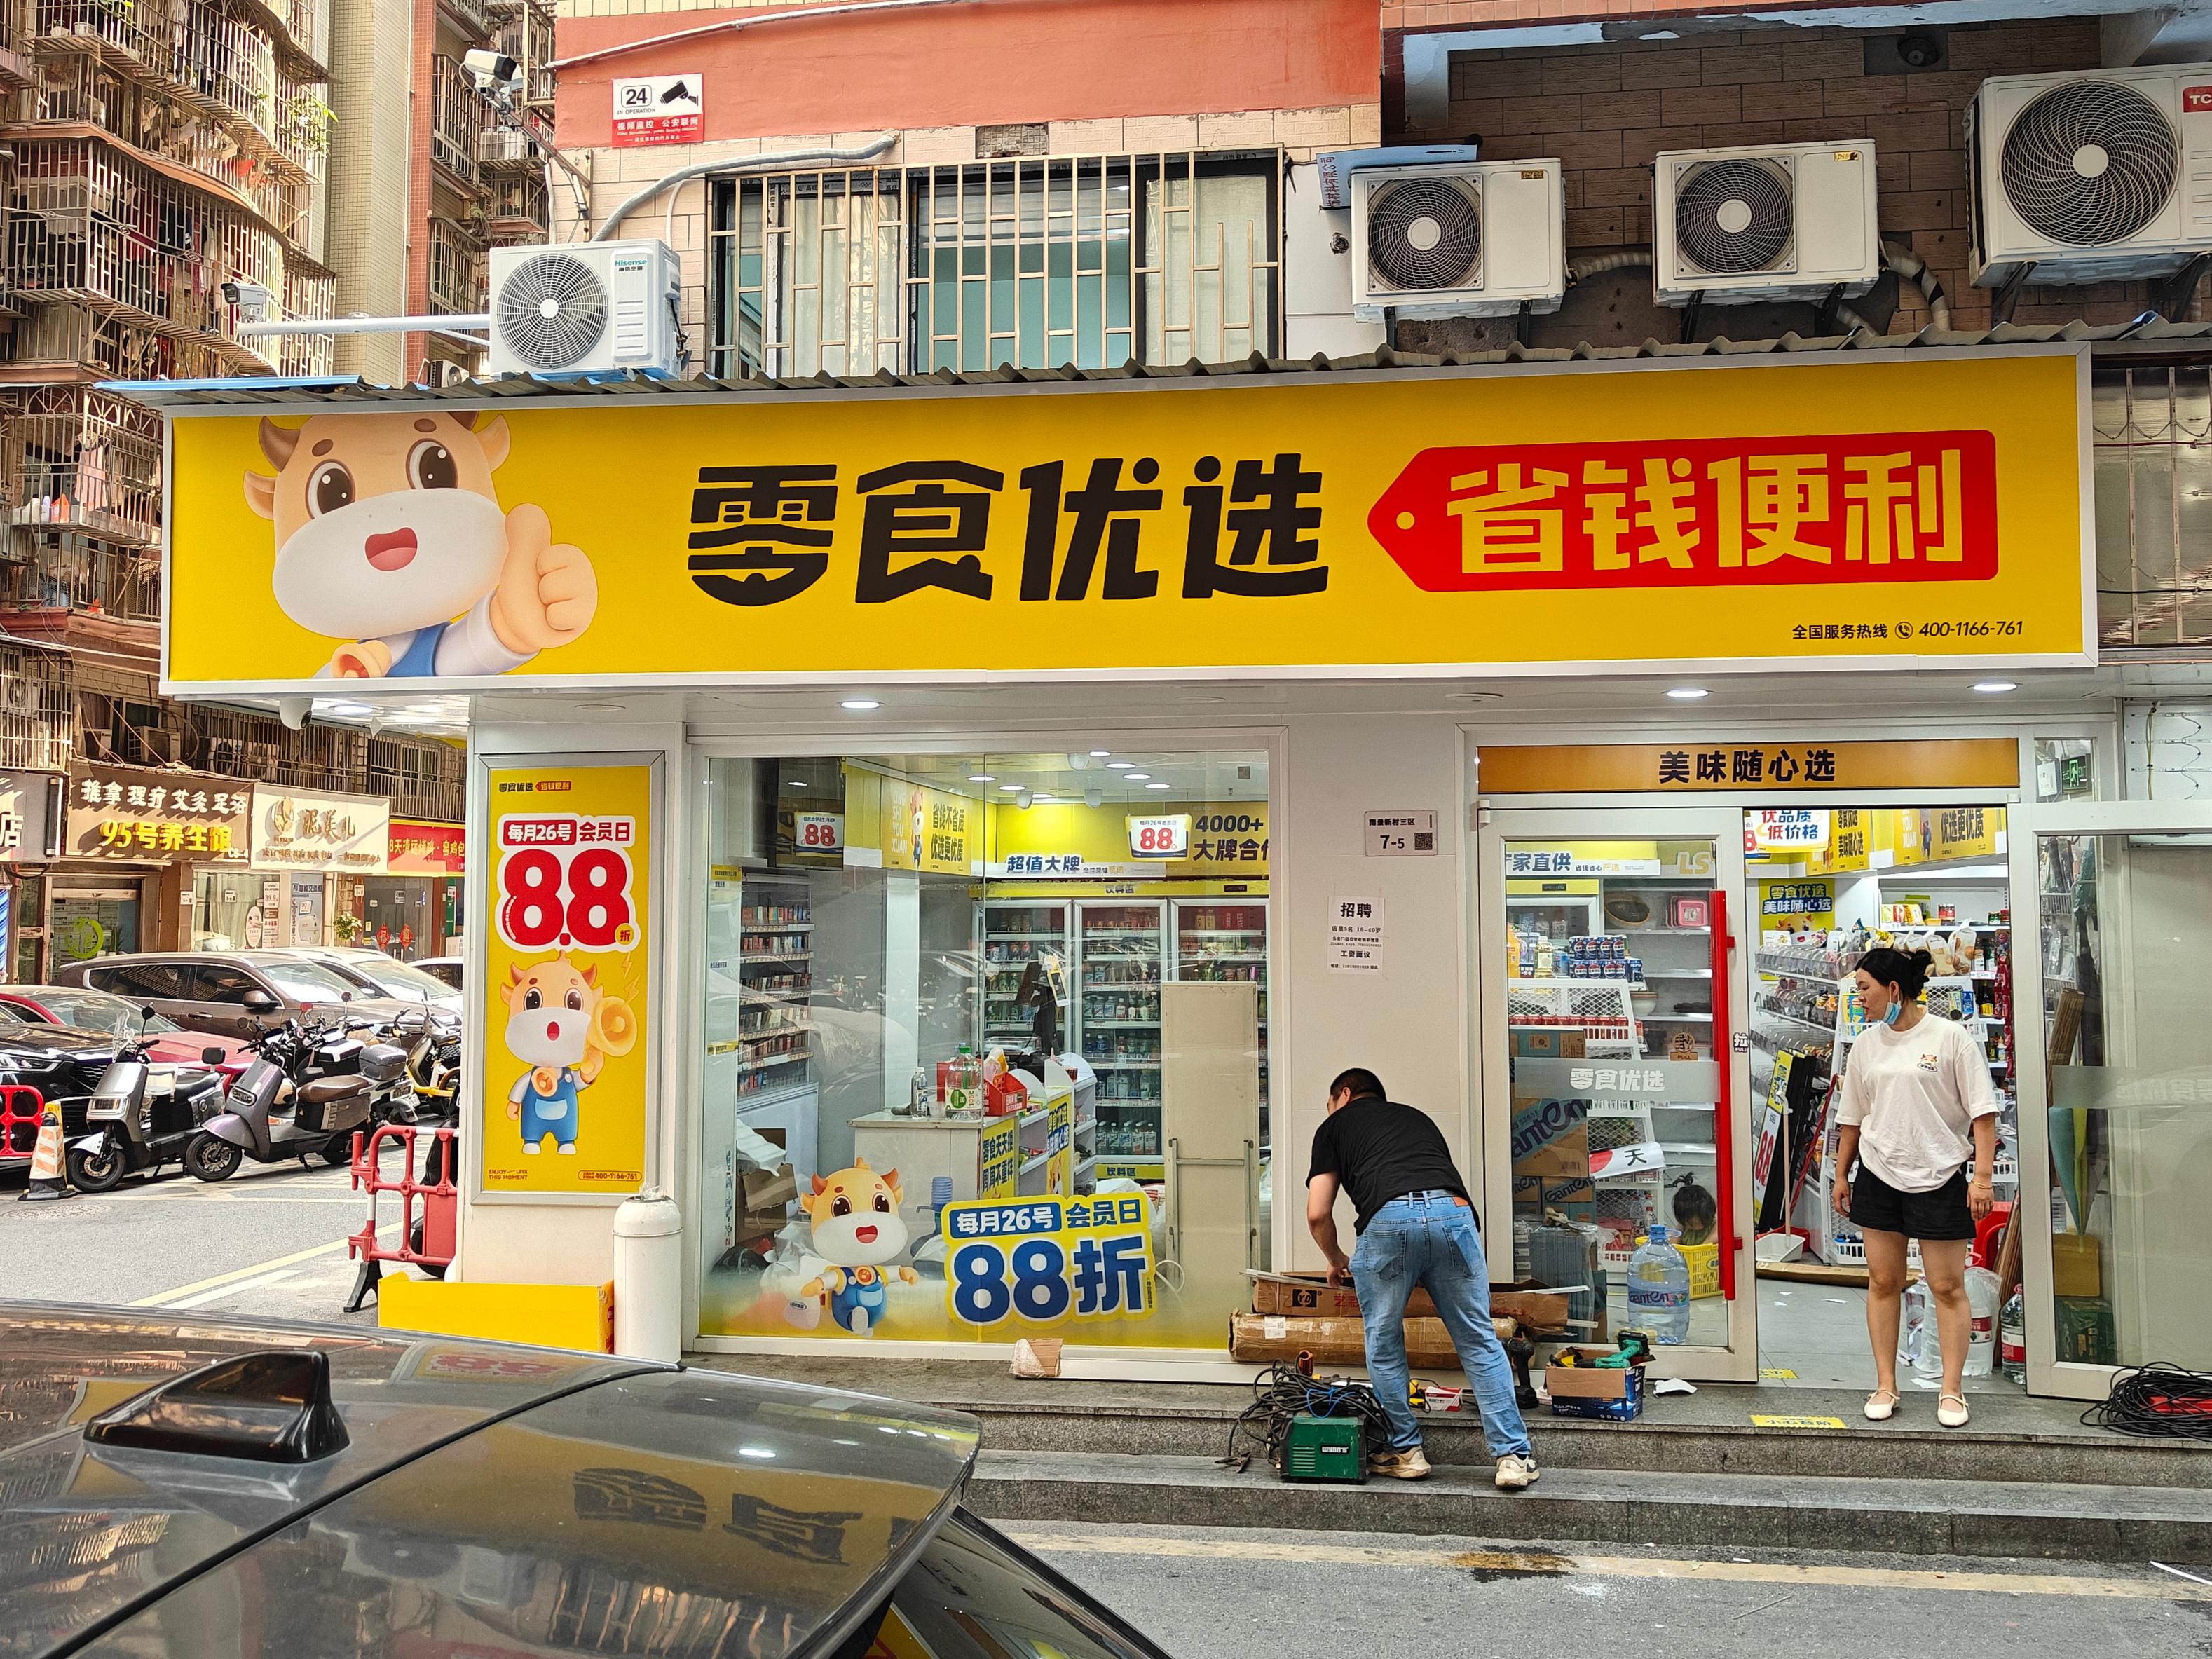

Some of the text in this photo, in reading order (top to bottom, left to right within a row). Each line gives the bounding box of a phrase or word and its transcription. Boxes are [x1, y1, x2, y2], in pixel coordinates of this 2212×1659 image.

[625, 88, 648, 105] 24
[617, 116, 698, 131] 视频监控 公安联网
[1447, 446, 1965, 573] 省钱便利
[687, 453, 1329, 607] 零食优选
[1792, 620, 2023, 639] 全国服务热线 400-1166-761
[1658, 749, 1836, 785] 美味随心选
[499, 782, 533, 792] 零食优选
[81, 779, 248, 815] 推拿 理疗 艾灸 足浴
[1195, 815, 1264, 833] 4000+
[1761, 810, 1812, 824] 优品质
[1902, 815, 1913, 831] YOU
[98, 819, 233, 852] 95号养生馆
[507, 821, 630, 842] 每月26号 会员日
[892, 821, 904, 837] YOU
[1767, 824, 1819, 840] 低价格
[1941, 808, 1985, 845] 优选更优质
[892, 838, 908, 854] XUAN
[1140, 828, 1173, 850] 88
[1379, 835, 1405, 849] 7-5
[1838, 831, 1864, 859] 美味随心选
[1006, 856, 1080, 873] 超值大牌
[503, 849, 631, 946] 8.8 折
[1770, 885, 1826, 898] 零食优选
[1340, 902, 1372, 918] 招聘
[1763, 899, 1831, 913] 美味随心选
[1570, 1067, 1666, 1091] 零食优选
[1624, 1148, 1647, 1166] 天
[1107, 1167, 1136, 1176] 饮料区
[957, 1199, 1142, 1234] 每月26号 会员日
[954, 1235, 1146, 1323] 88折
